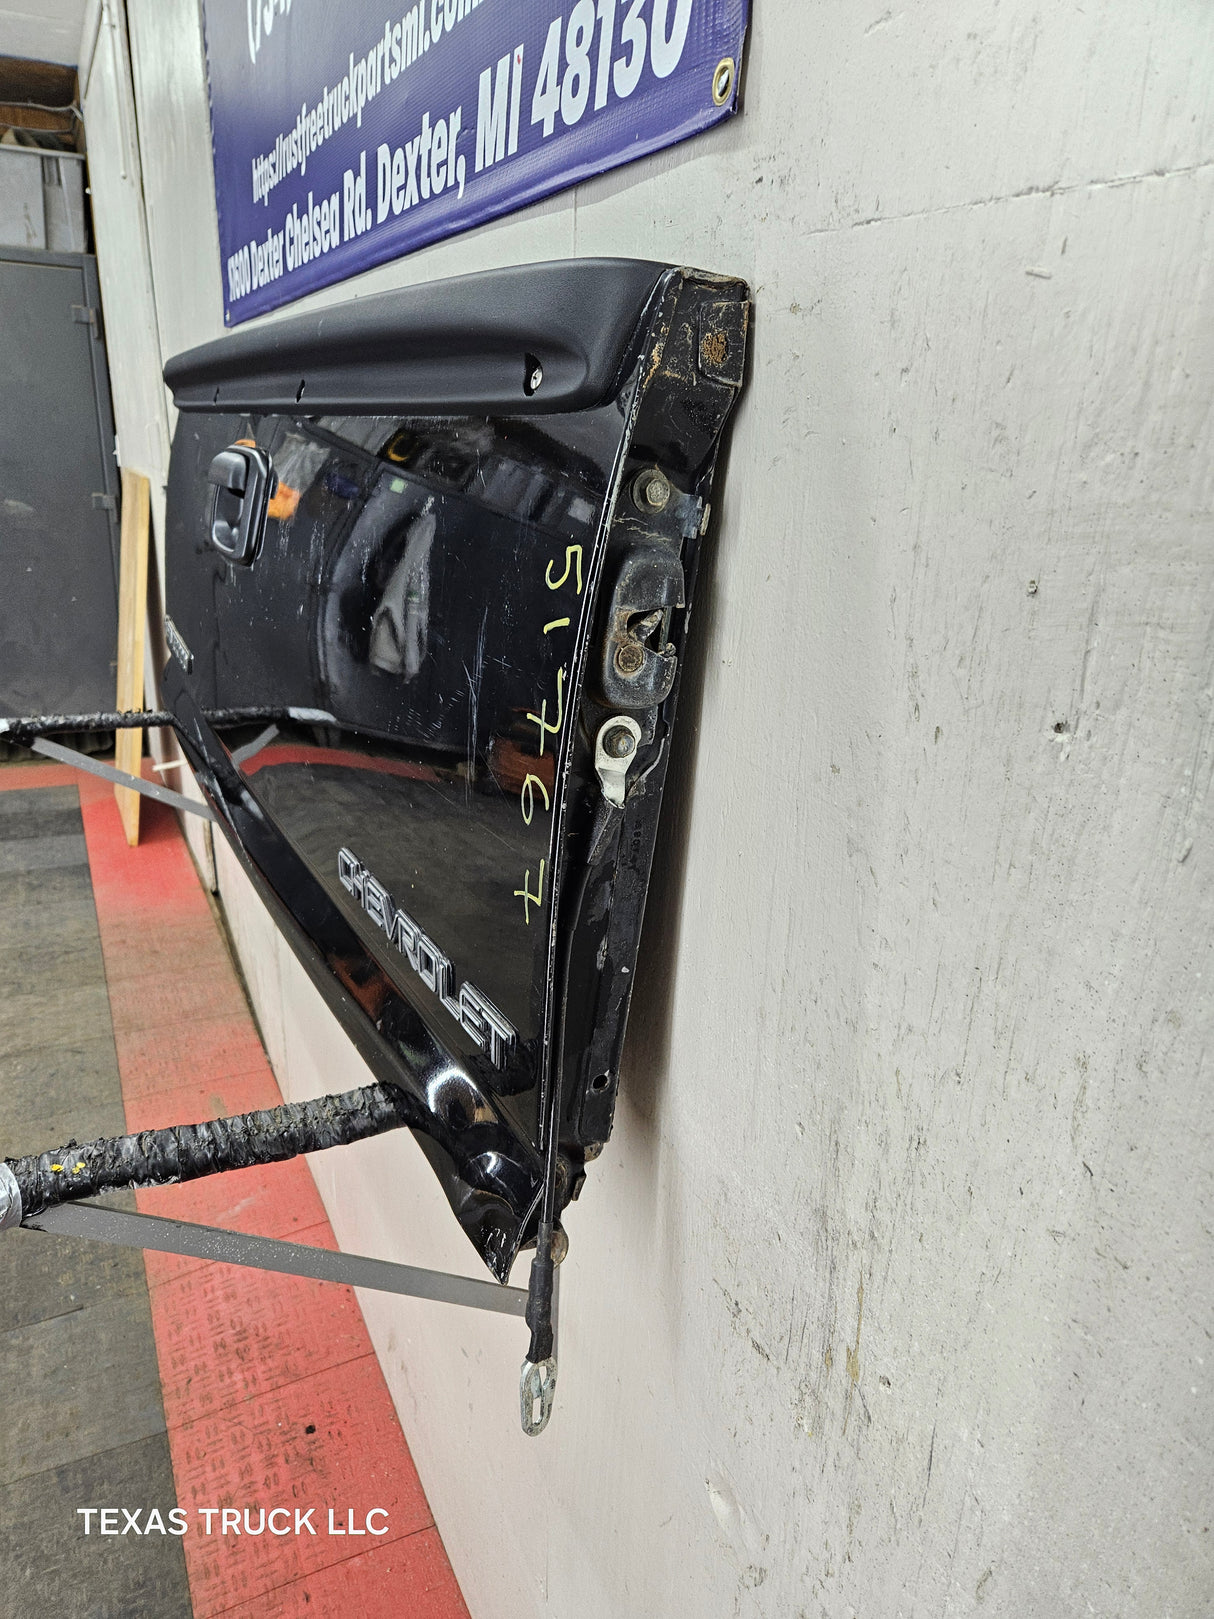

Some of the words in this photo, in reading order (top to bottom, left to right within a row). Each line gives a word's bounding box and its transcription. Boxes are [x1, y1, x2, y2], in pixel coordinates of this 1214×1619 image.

[250, 227, 284, 291] Dexter
[285, 190, 340, 272] Chelsea
[343, 150, 372, 242] Rd.
[377, 105, 466, 225] Dexter,
[475, 43, 524, 174] MI
[531, 0, 693, 138] 48130
[338, 847, 519, 1070] CHEVROLET
